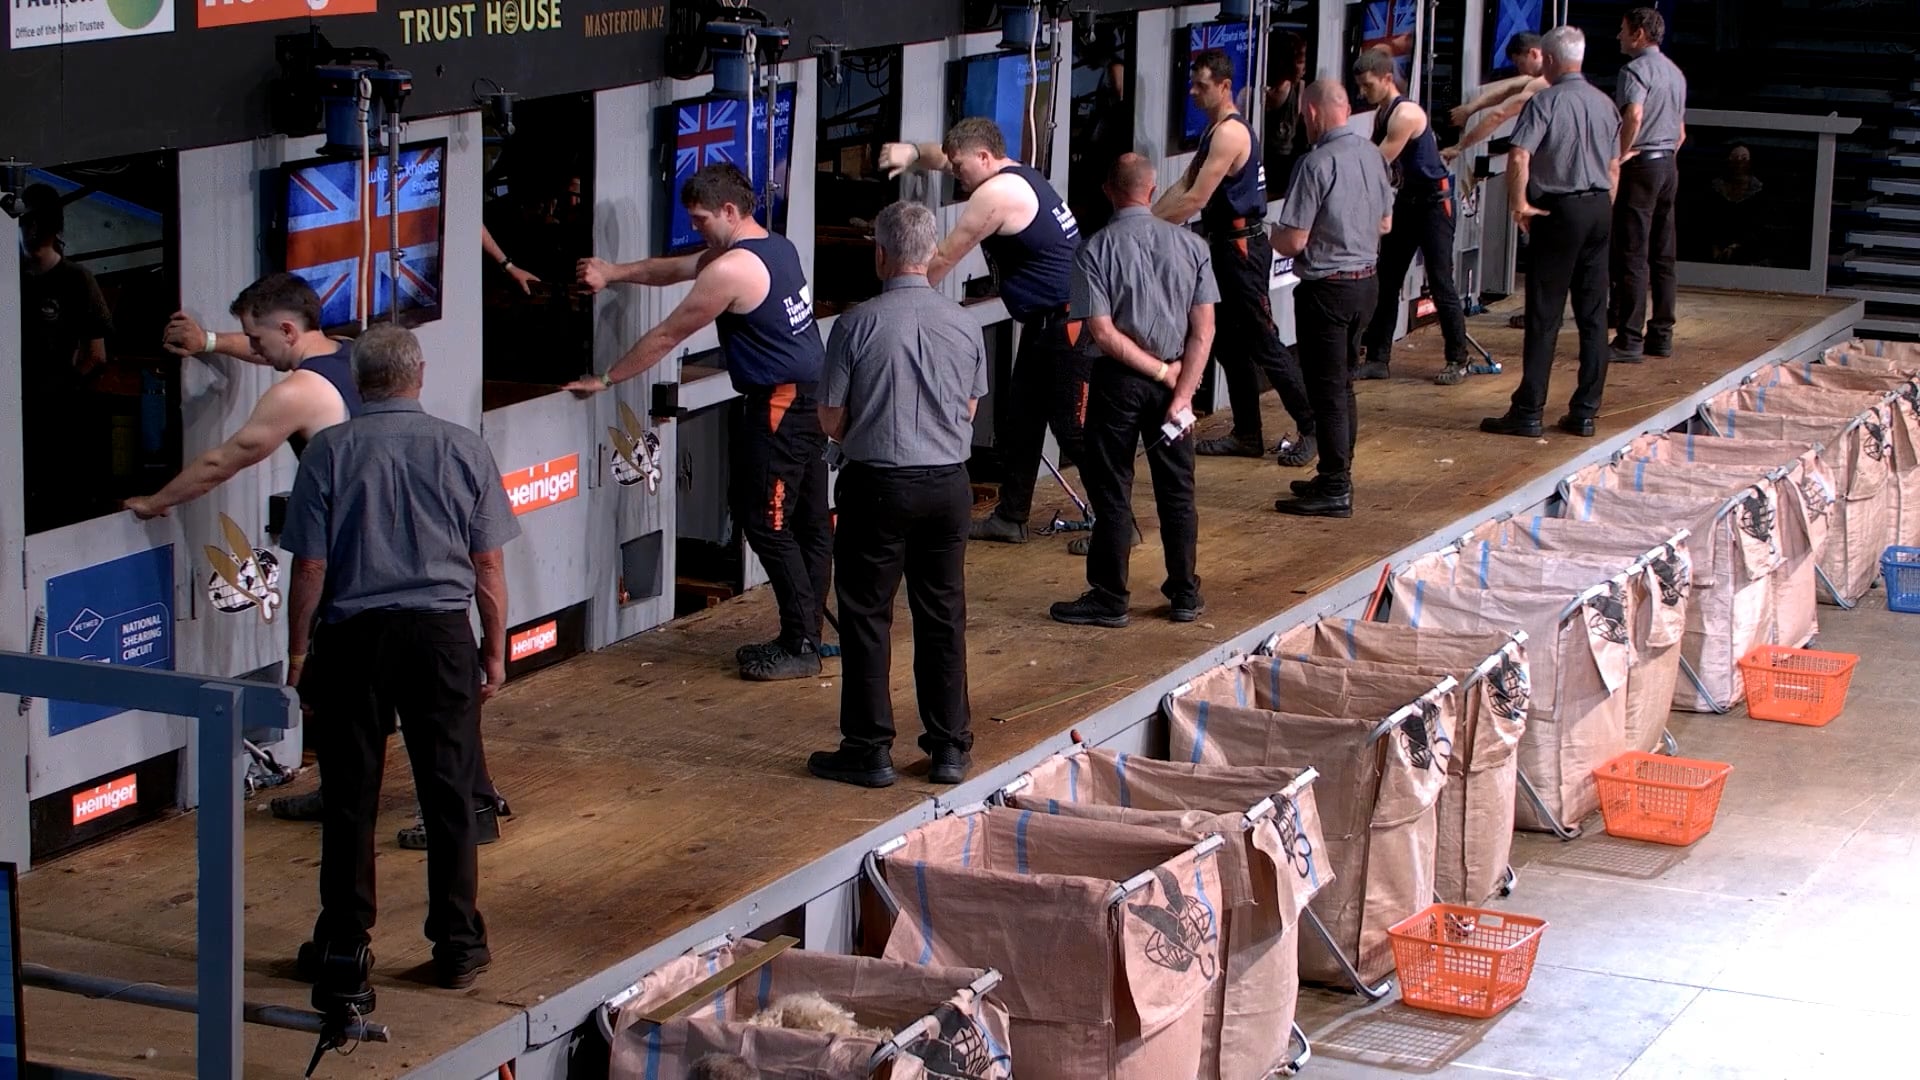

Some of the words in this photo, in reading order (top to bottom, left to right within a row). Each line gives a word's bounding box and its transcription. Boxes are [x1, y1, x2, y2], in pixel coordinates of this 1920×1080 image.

[15, 27, 36, 38] Office
[36, 25, 44, 36] of
[45, 24, 57, 35] the
[79, 20, 105, 32] Trustee
[399, 4, 477, 45] TRUST
[486, 0, 562, 35] HOUSE
[584, 6, 665, 38] MASTERTON.NZ
[783, 296, 794, 309] TE
[122, 614, 162, 635] NATIONAL
[122, 627, 162, 648] SHEARING
[512, 627, 556, 656] Heiniger
[122, 642, 154, 661] CIRCUIT
[76, 782, 136, 817] Heiniger
